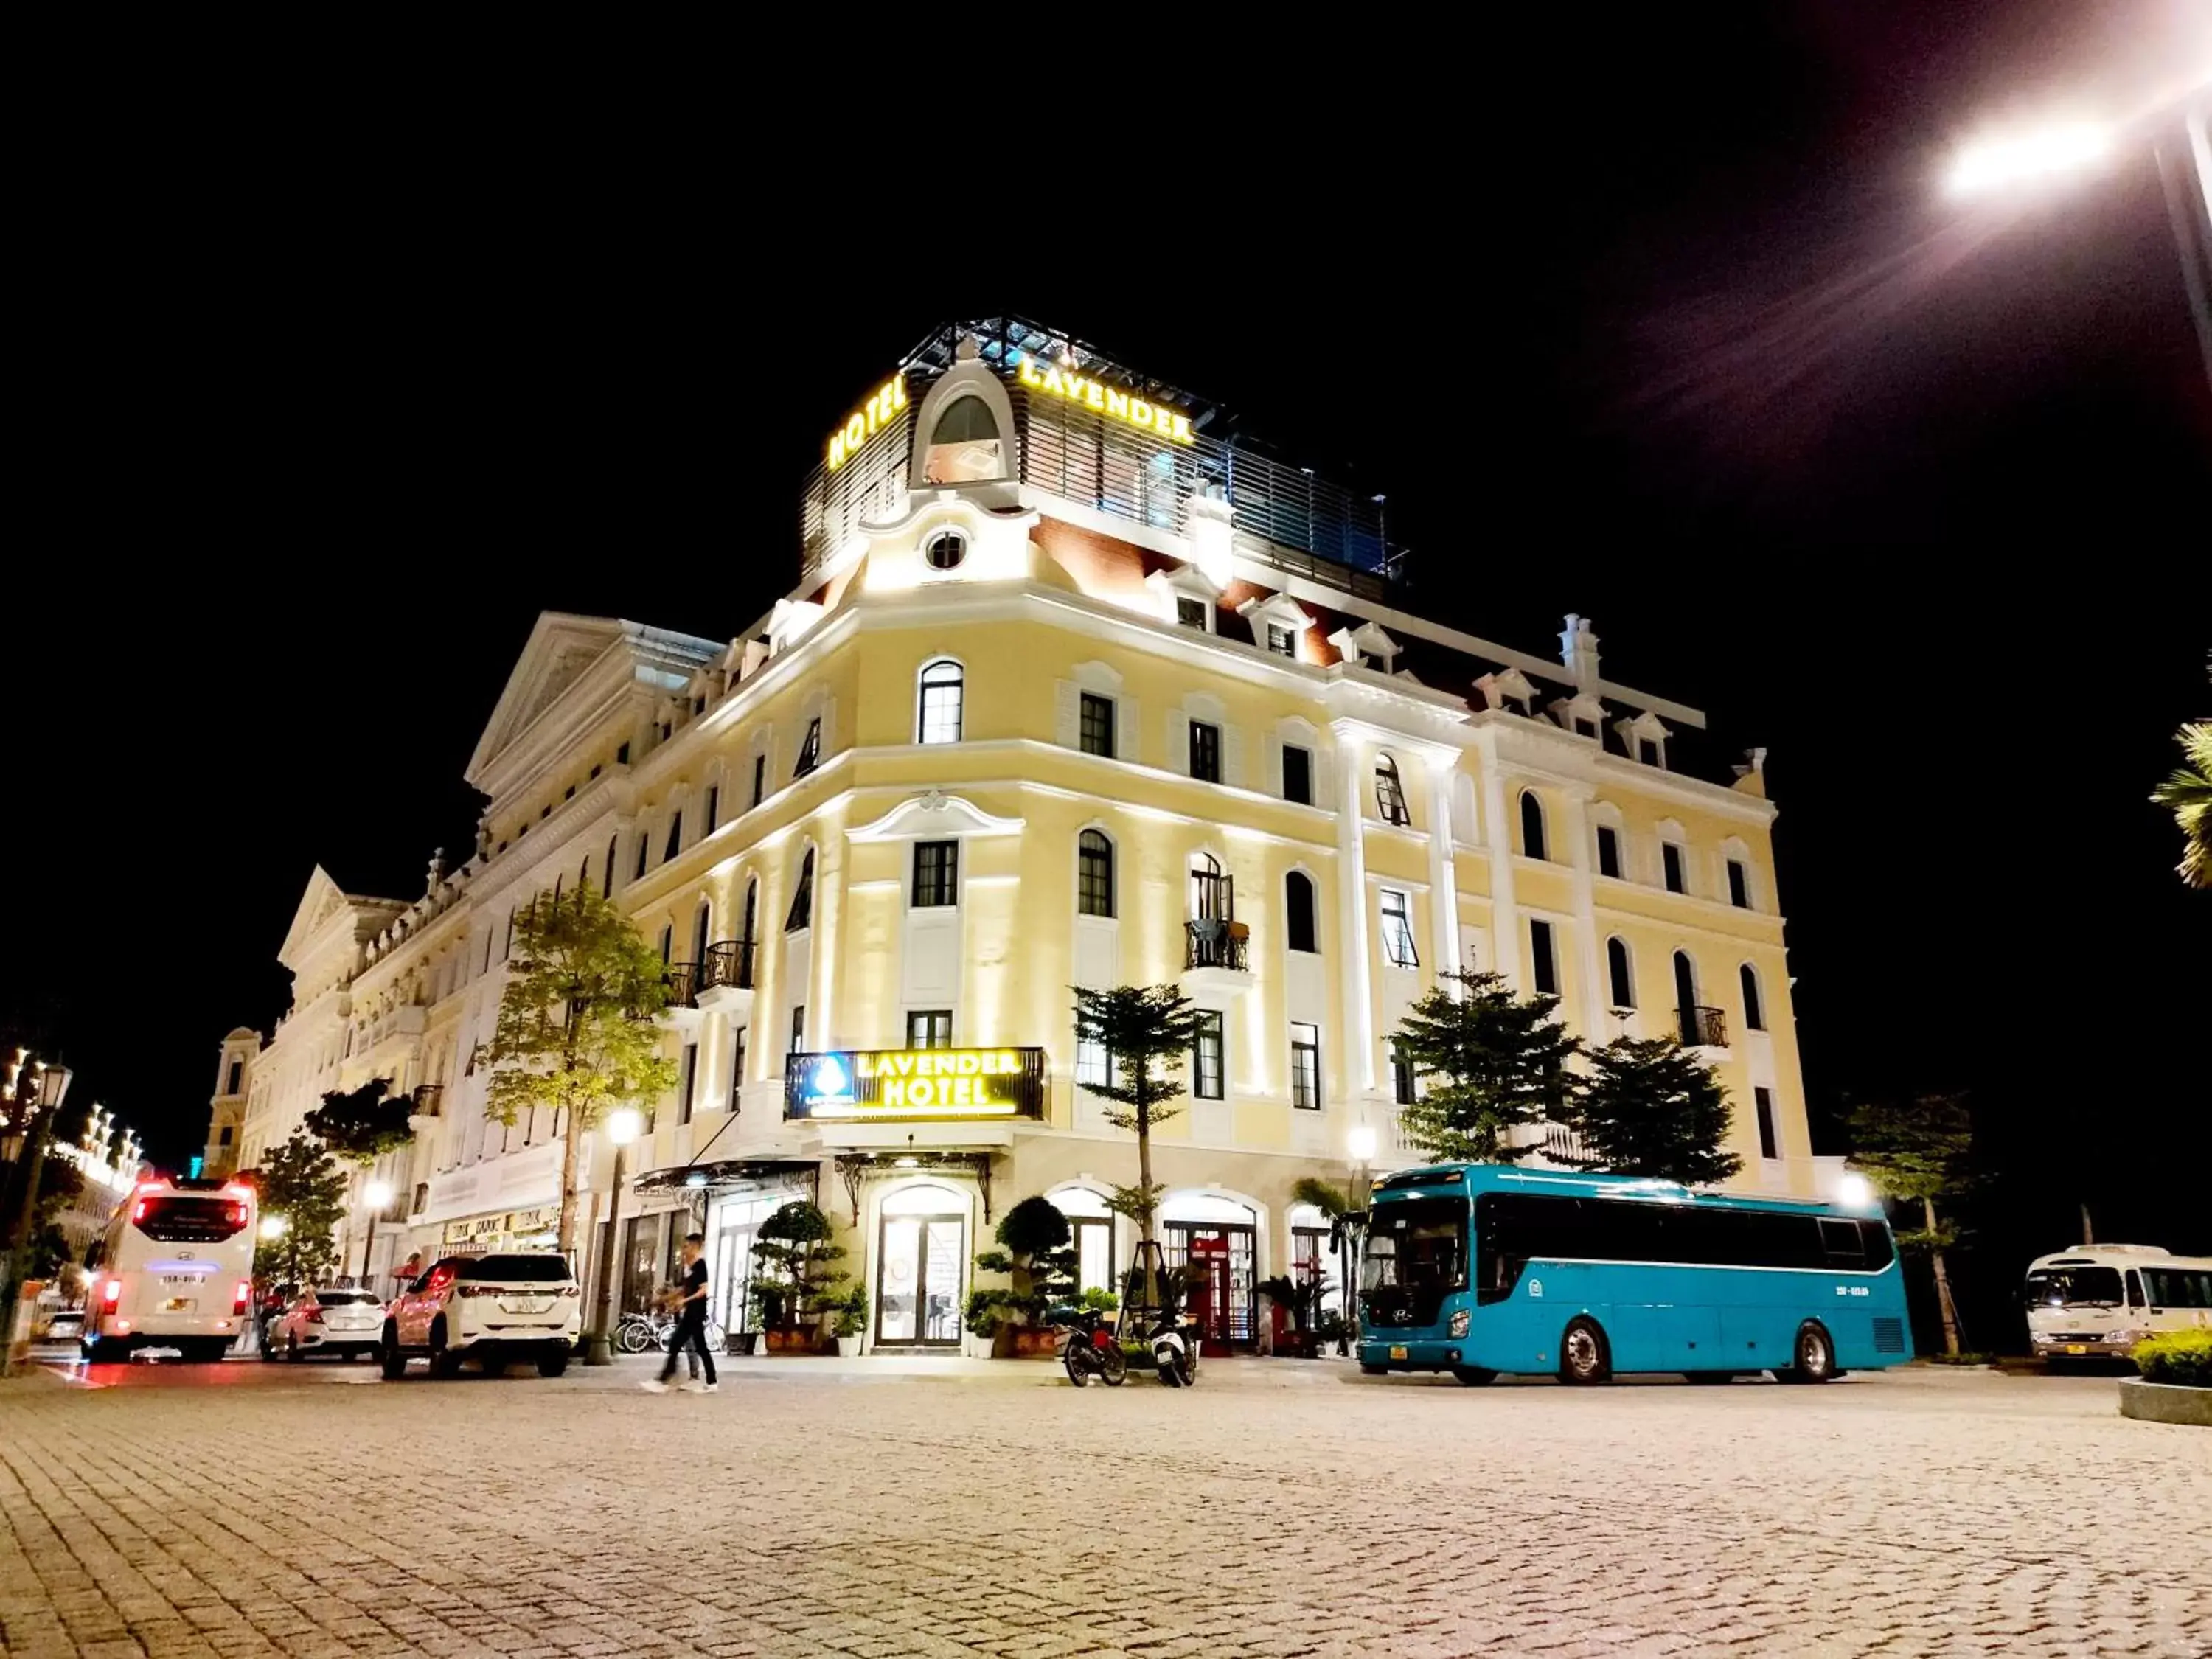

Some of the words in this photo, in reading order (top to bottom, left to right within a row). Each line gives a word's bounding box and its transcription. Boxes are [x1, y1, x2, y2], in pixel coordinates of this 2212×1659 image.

[828, 373, 907, 471] HOTEL
[1020, 355, 1194, 445] LAVENDER
[857, 1054, 1022, 1077] LAVENDER
[884, 1077, 990, 1106] HOTEL
